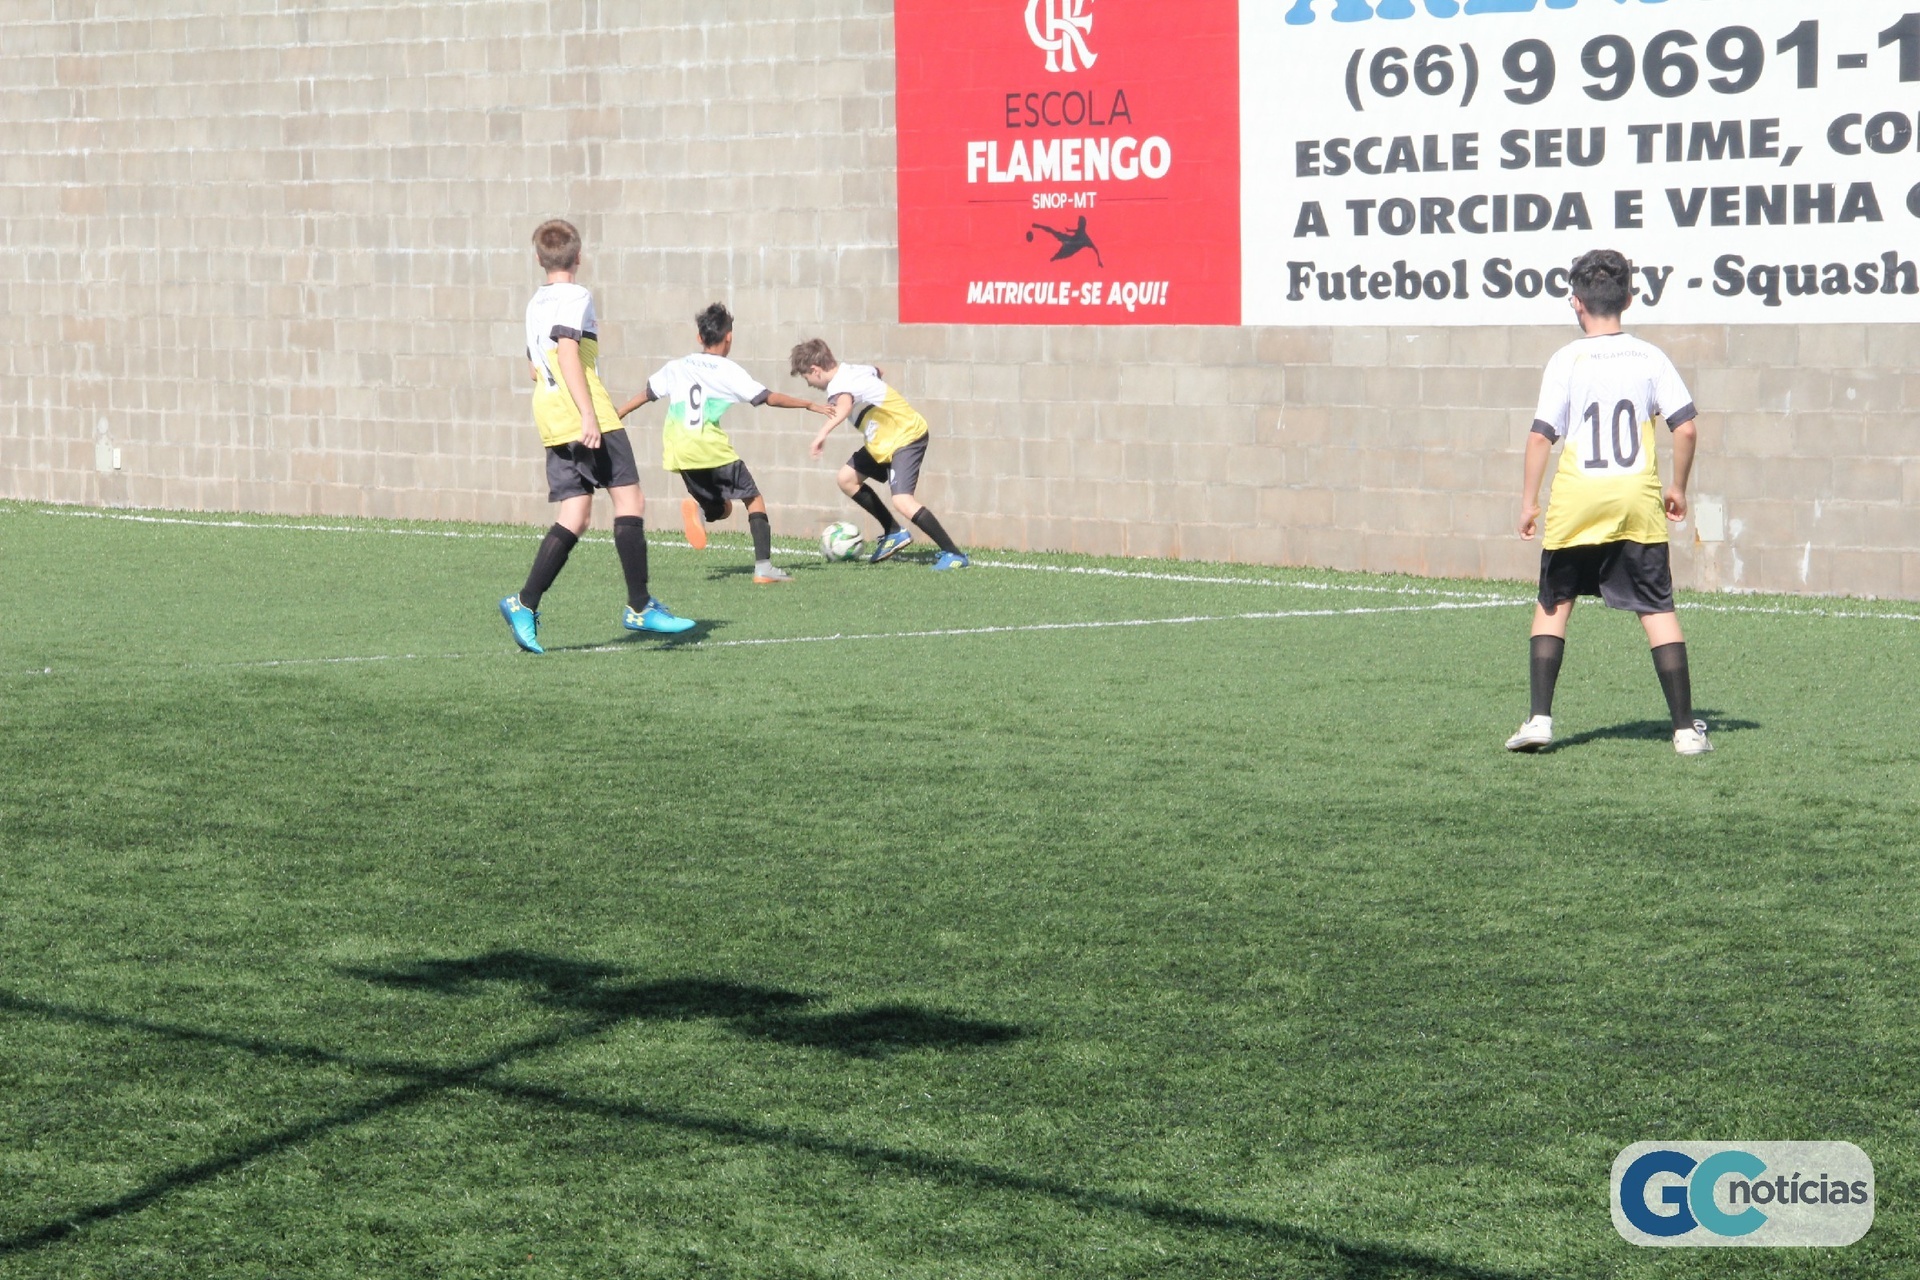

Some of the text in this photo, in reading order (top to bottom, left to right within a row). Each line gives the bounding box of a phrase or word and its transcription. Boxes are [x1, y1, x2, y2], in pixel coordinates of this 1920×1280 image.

[1345, 42, 1479, 112] (66)
[1502, 38, 1556, 105] 9
[1005, 89, 1132, 128] ESCOLA
[967, 136, 1171, 183] FLAMENGO
[1295, 110, 1920, 178] ESCALE SEU TIME, CO
[1032, 191, 1097, 209] SINOP-MT
[1293, 200, 1330, 237] A
[1345, 191, 1593, 236] TORCIDA
[1614, 189, 1643, 229] E
[1665, 181, 1884, 227] VENHA
[967, 281, 1169, 312] MATRICULE-SE AQUI!
[1286, 260, 1469, 301] Futebol
[1712, 250, 1920, 307] Squash
[689, 384, 702, 426] 9
[1584, 399, 1640, 468] 10
